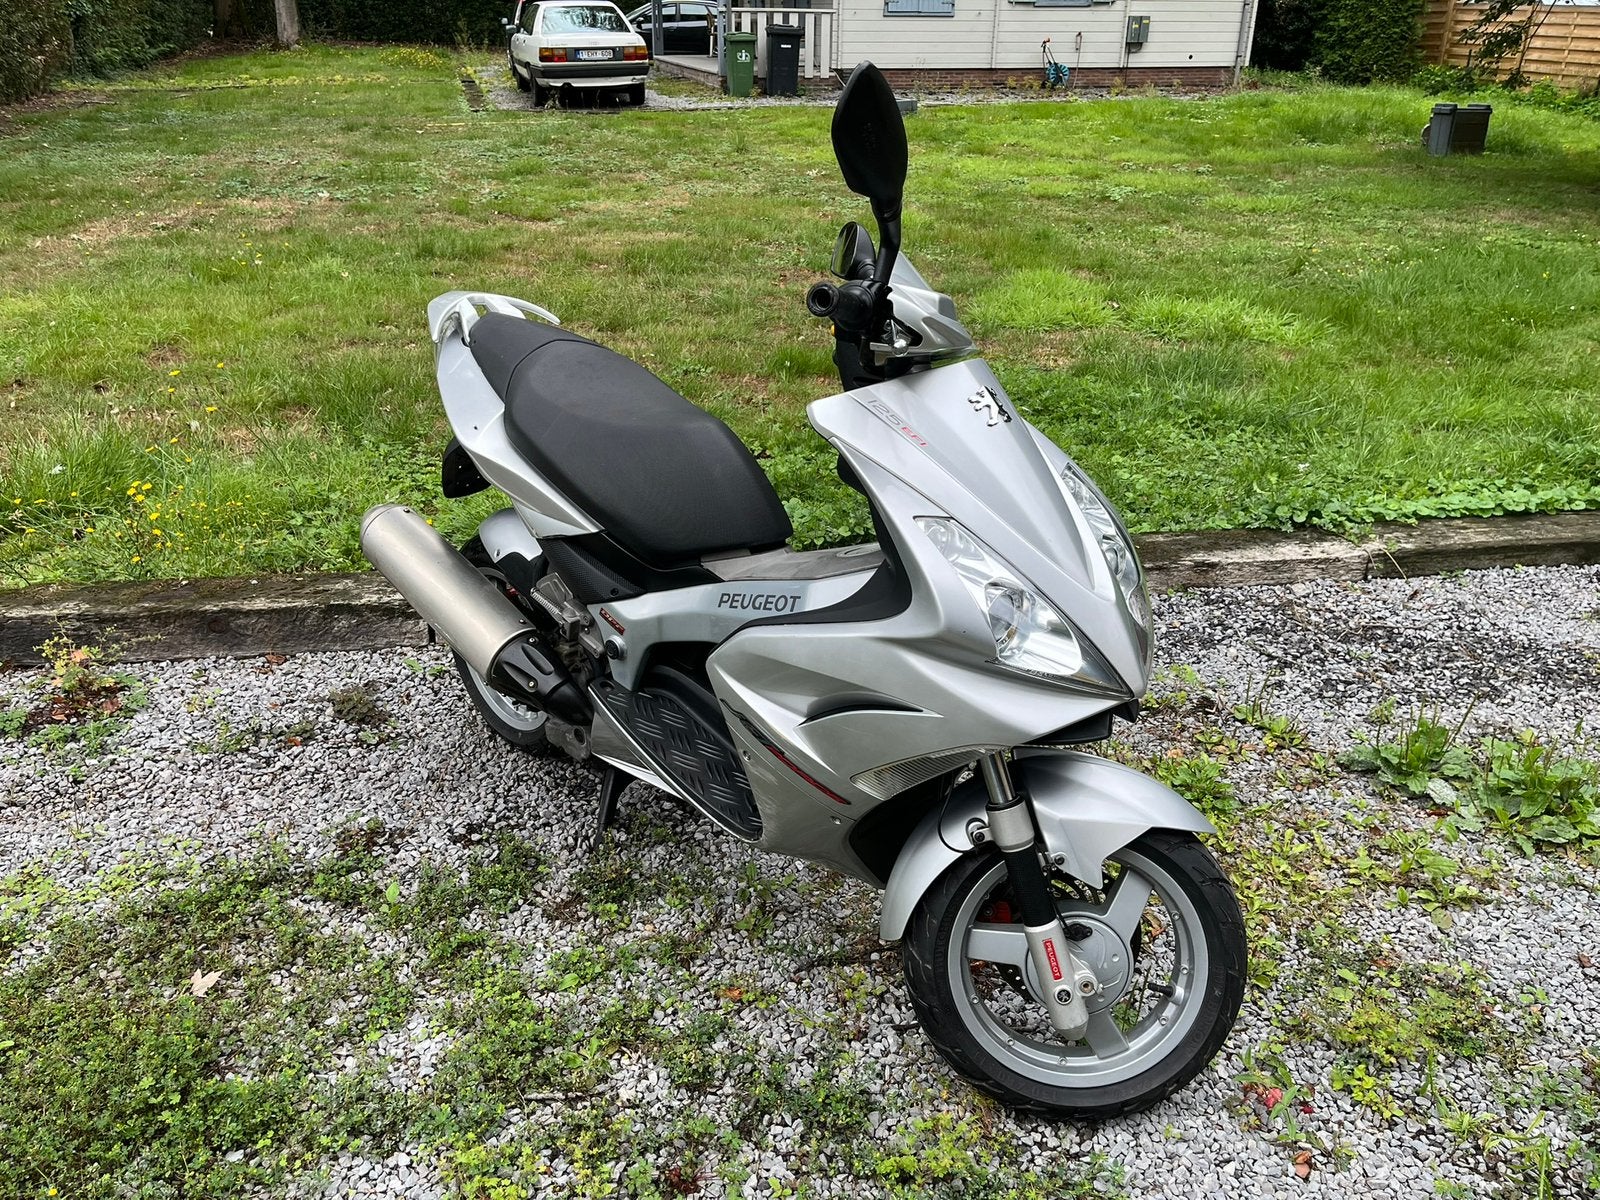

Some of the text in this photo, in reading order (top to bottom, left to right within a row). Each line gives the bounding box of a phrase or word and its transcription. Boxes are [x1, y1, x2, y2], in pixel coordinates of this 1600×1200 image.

[867, 398, 929, 448] 125 EFI
[717, 592, 802, 613] PEUGEOT
[1045, 941, 1061, 977] PEUGEOT
